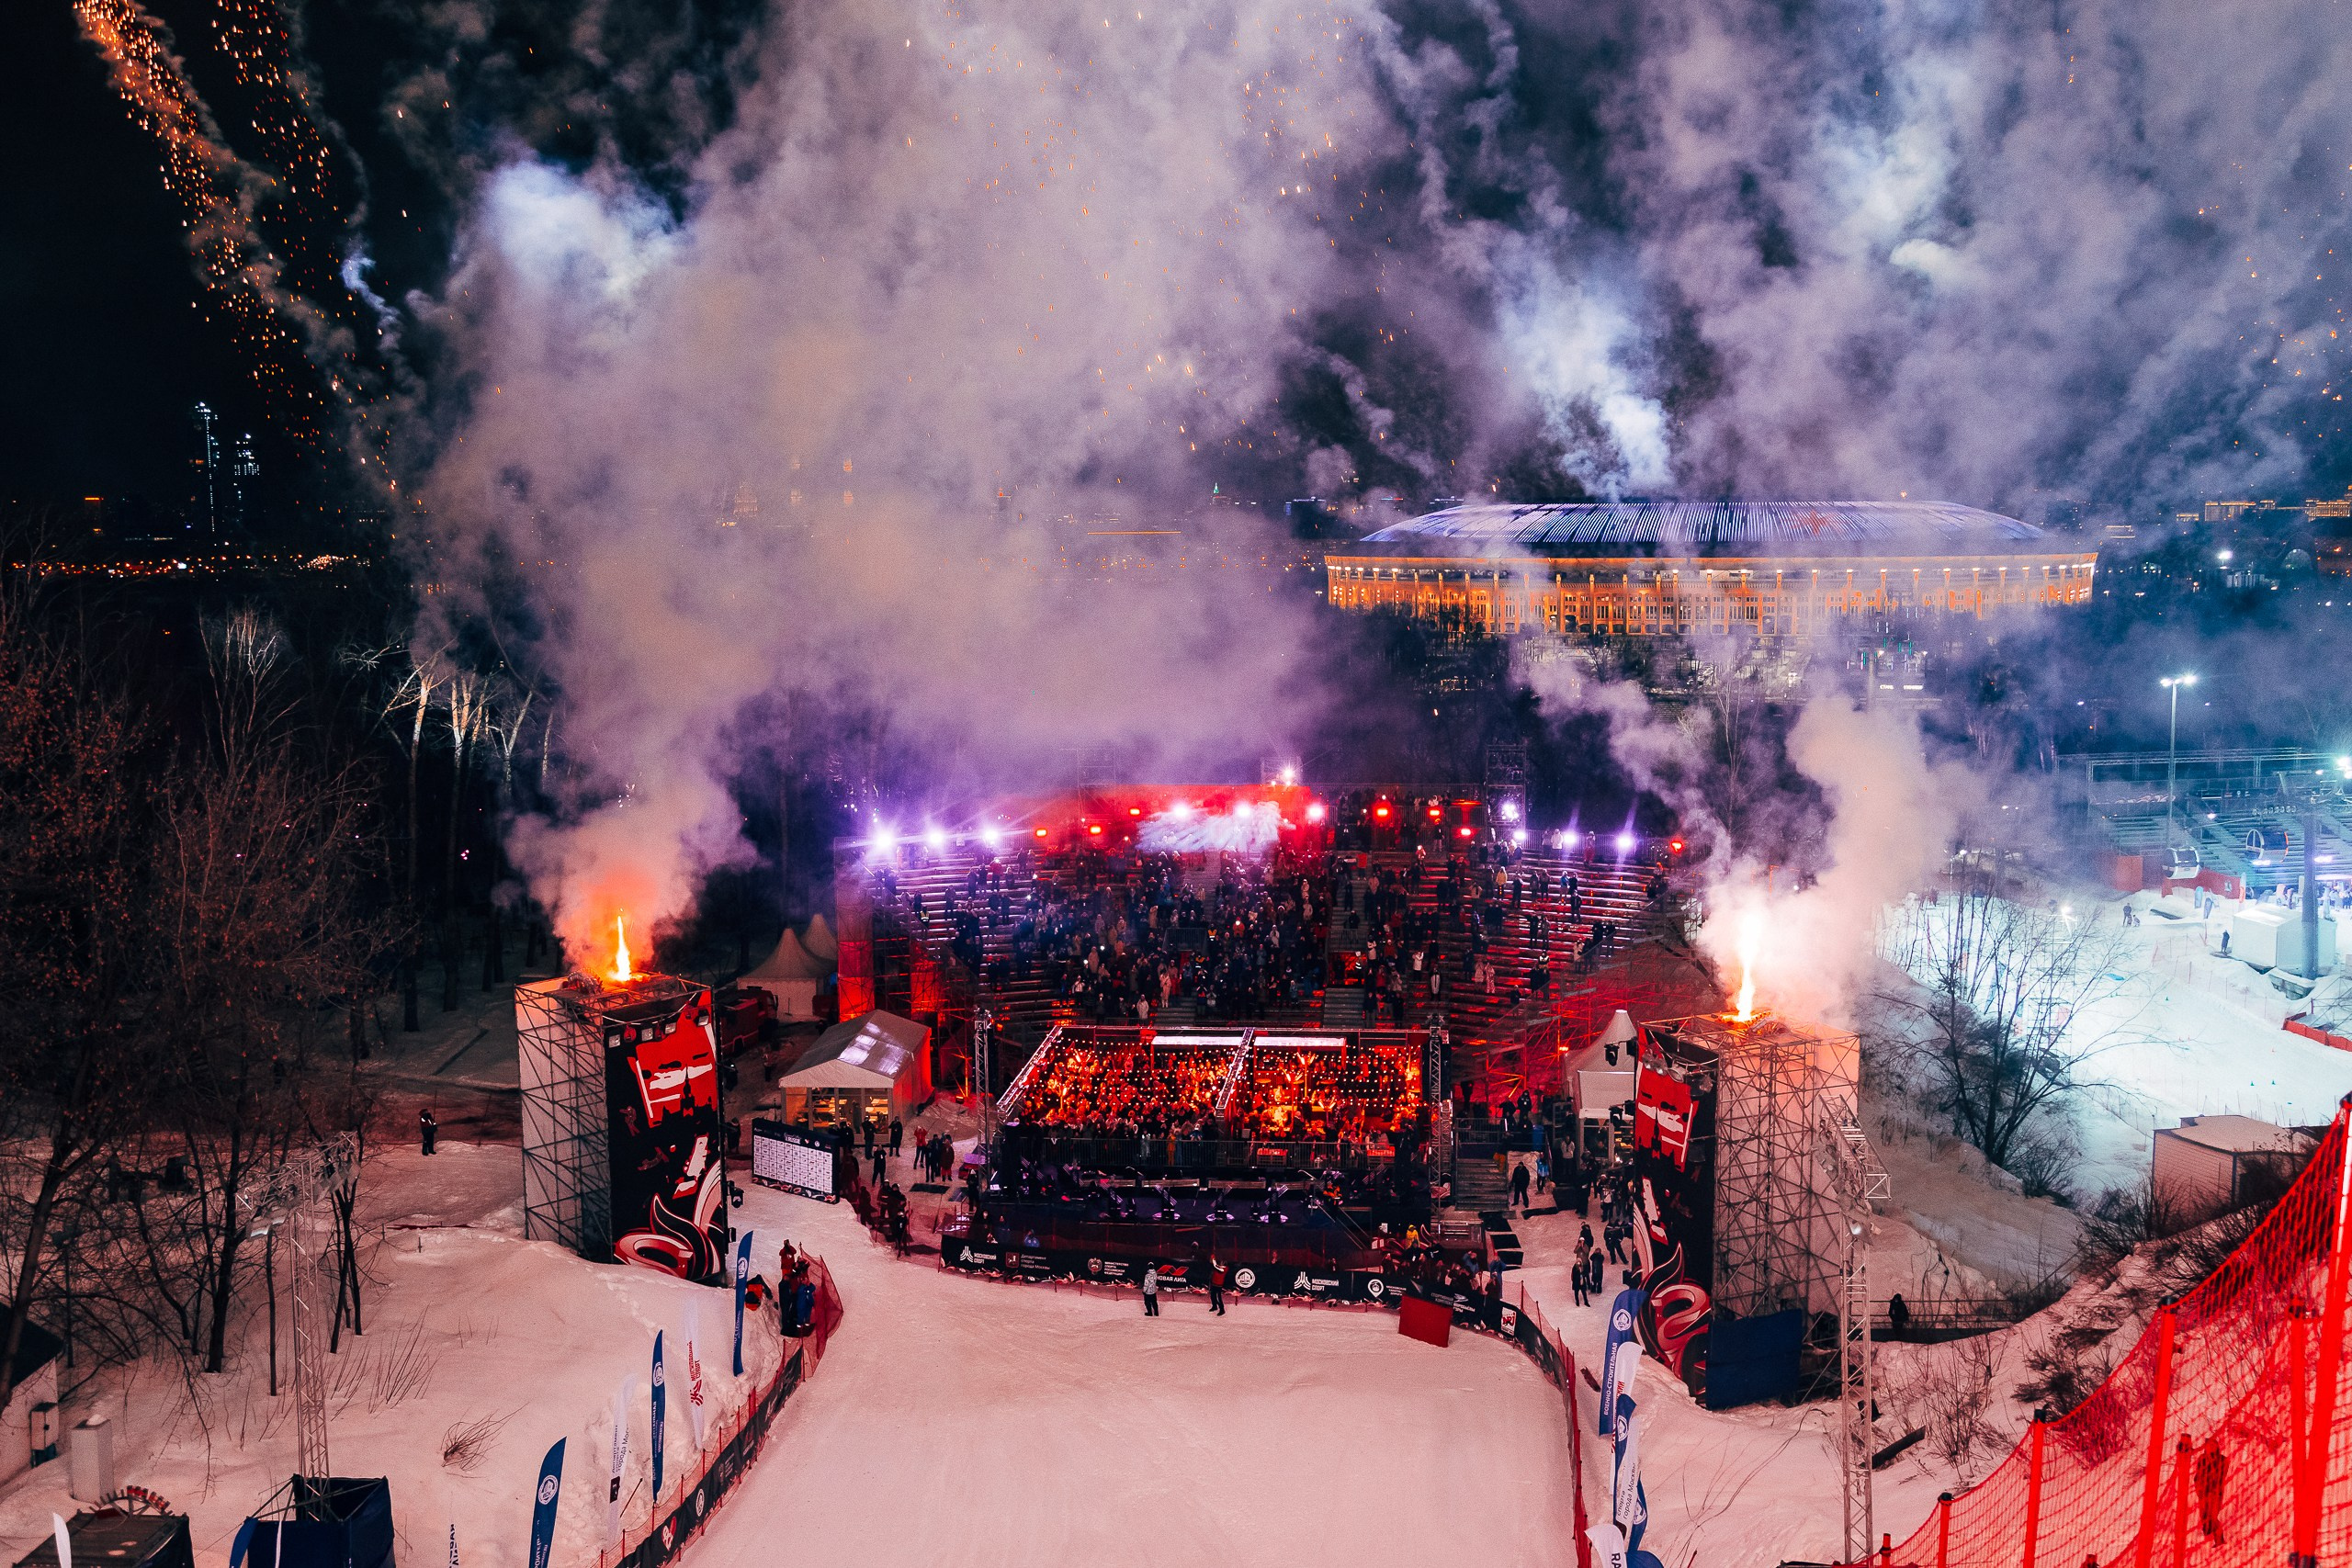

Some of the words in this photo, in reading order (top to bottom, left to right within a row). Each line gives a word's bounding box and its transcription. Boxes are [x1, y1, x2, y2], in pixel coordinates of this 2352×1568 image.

[1603, 1342, 1618, 1416] ВОЕННО-СТРОИТЕЛЬНАЯ
[1617, 1490, 1625, 1517] спорта
[1623, 1494, 1633, 1520] города
